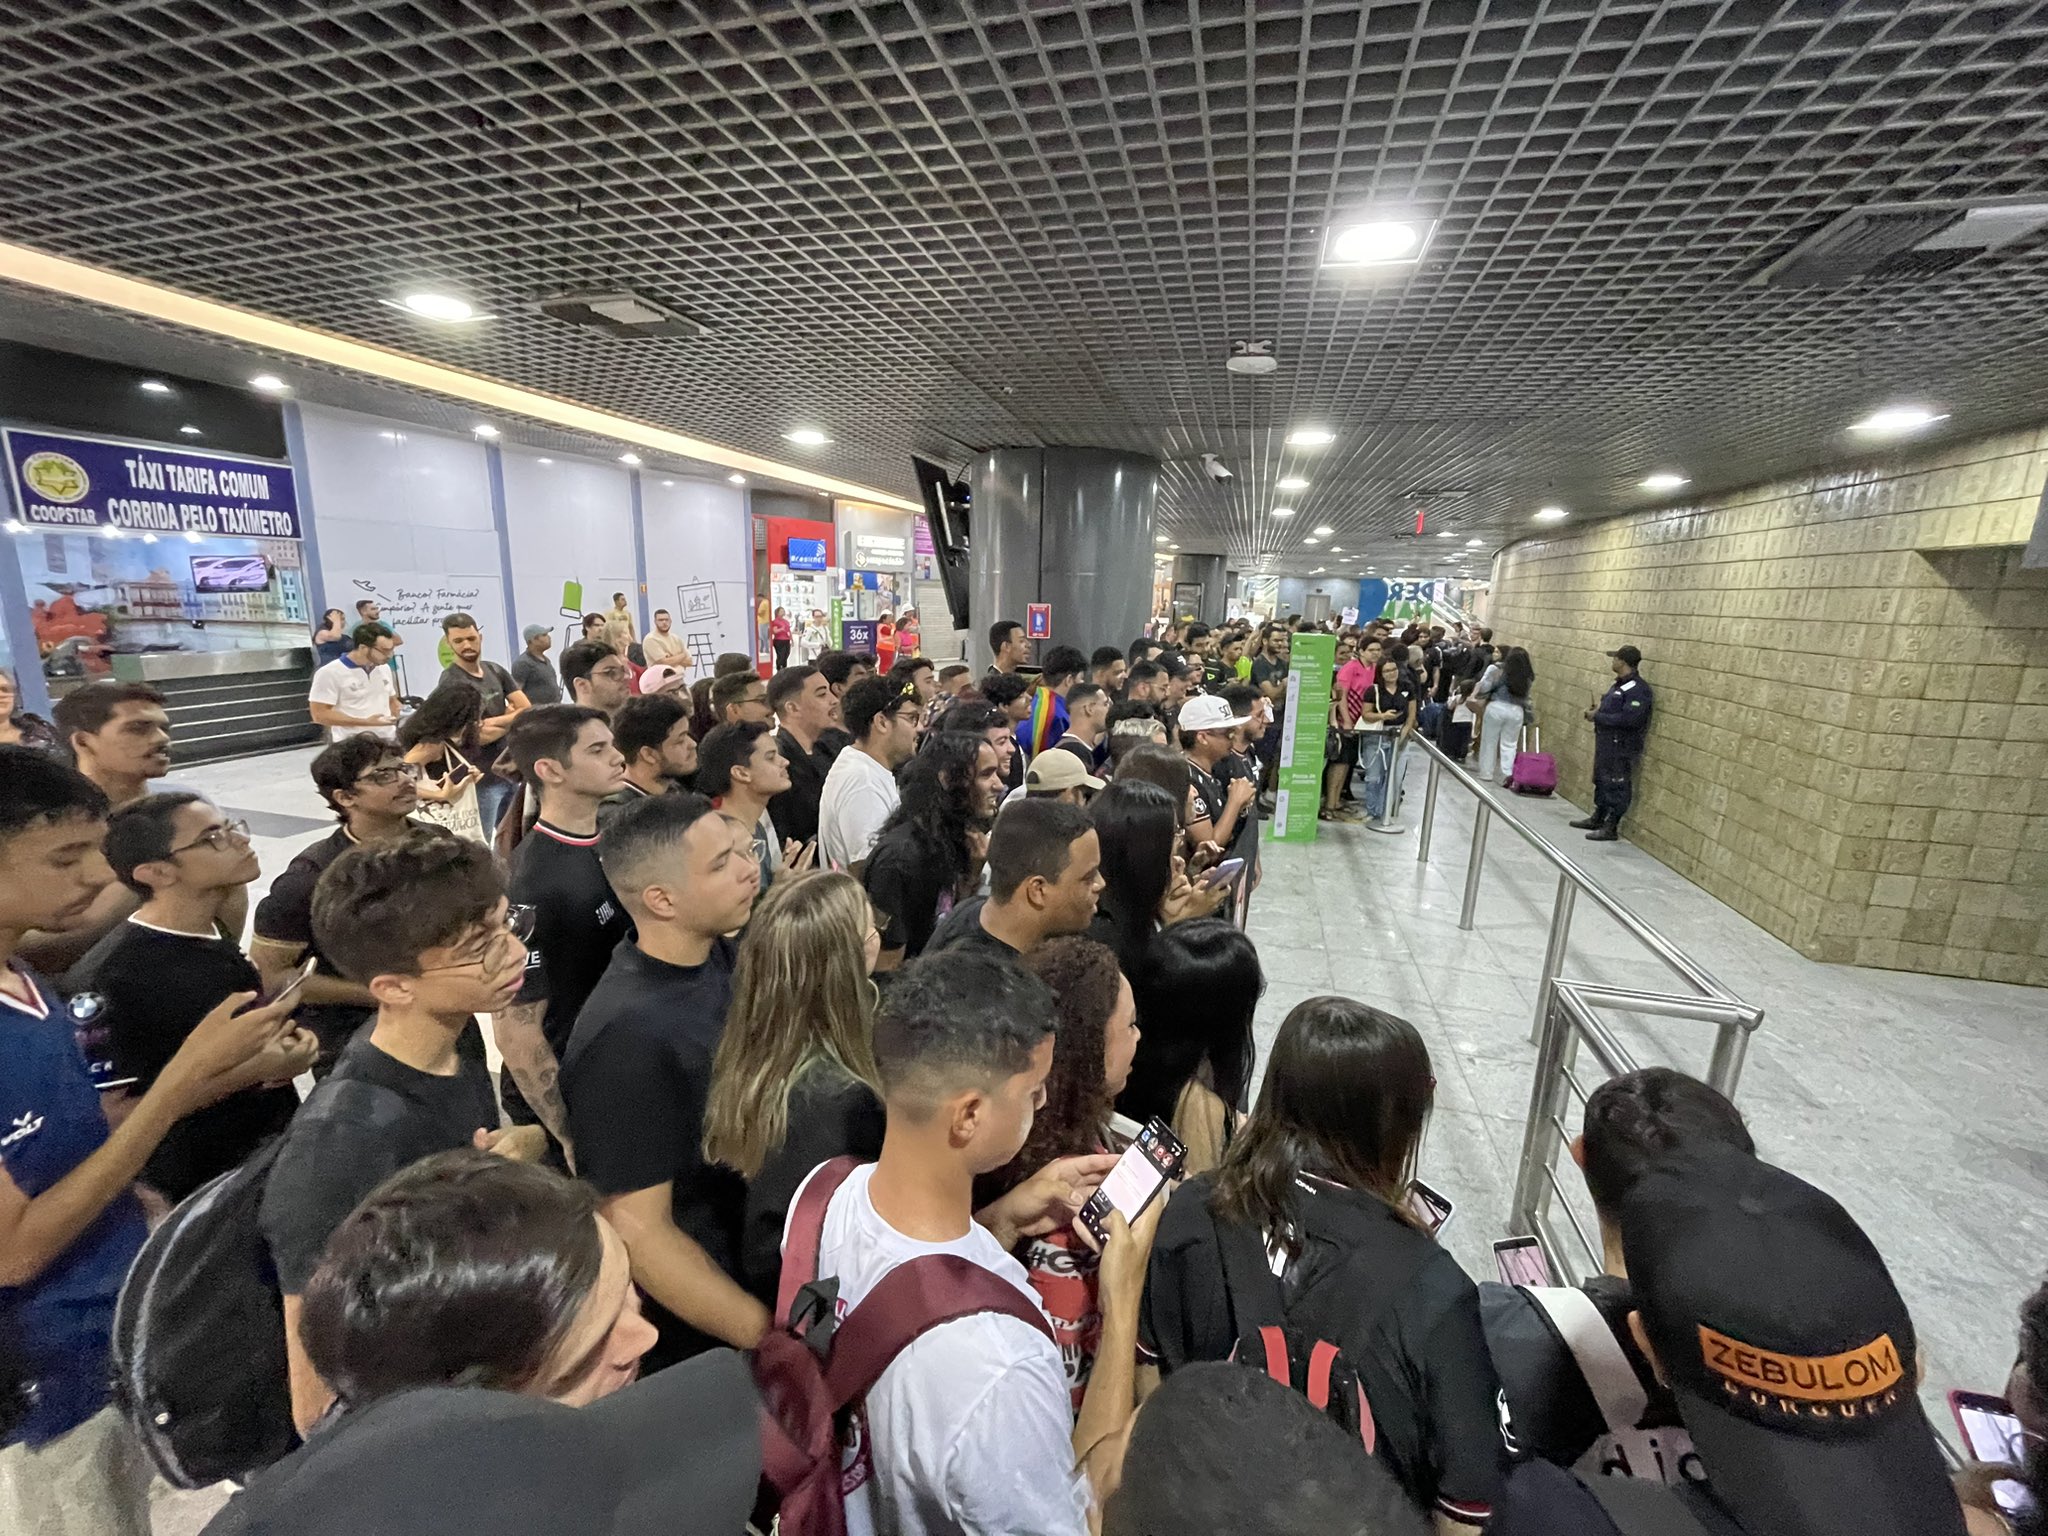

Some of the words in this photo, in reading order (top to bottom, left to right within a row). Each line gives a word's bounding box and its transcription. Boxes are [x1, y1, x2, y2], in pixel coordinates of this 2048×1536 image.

[124, 454, 166, 490] TÁXI
[166, 465, 218, 495] TARIFA
[218, 470, 270, 500] COMUM
[30, 504, 97, 525] COOPSTAR
[107, 498, 180, 530] CORRIDA
[180, 505, 218, 532] PELO
[218, 503, 293, 536] TAXÍMETRO
[1709, 1337, 1897, 1391] ZEBULOM
